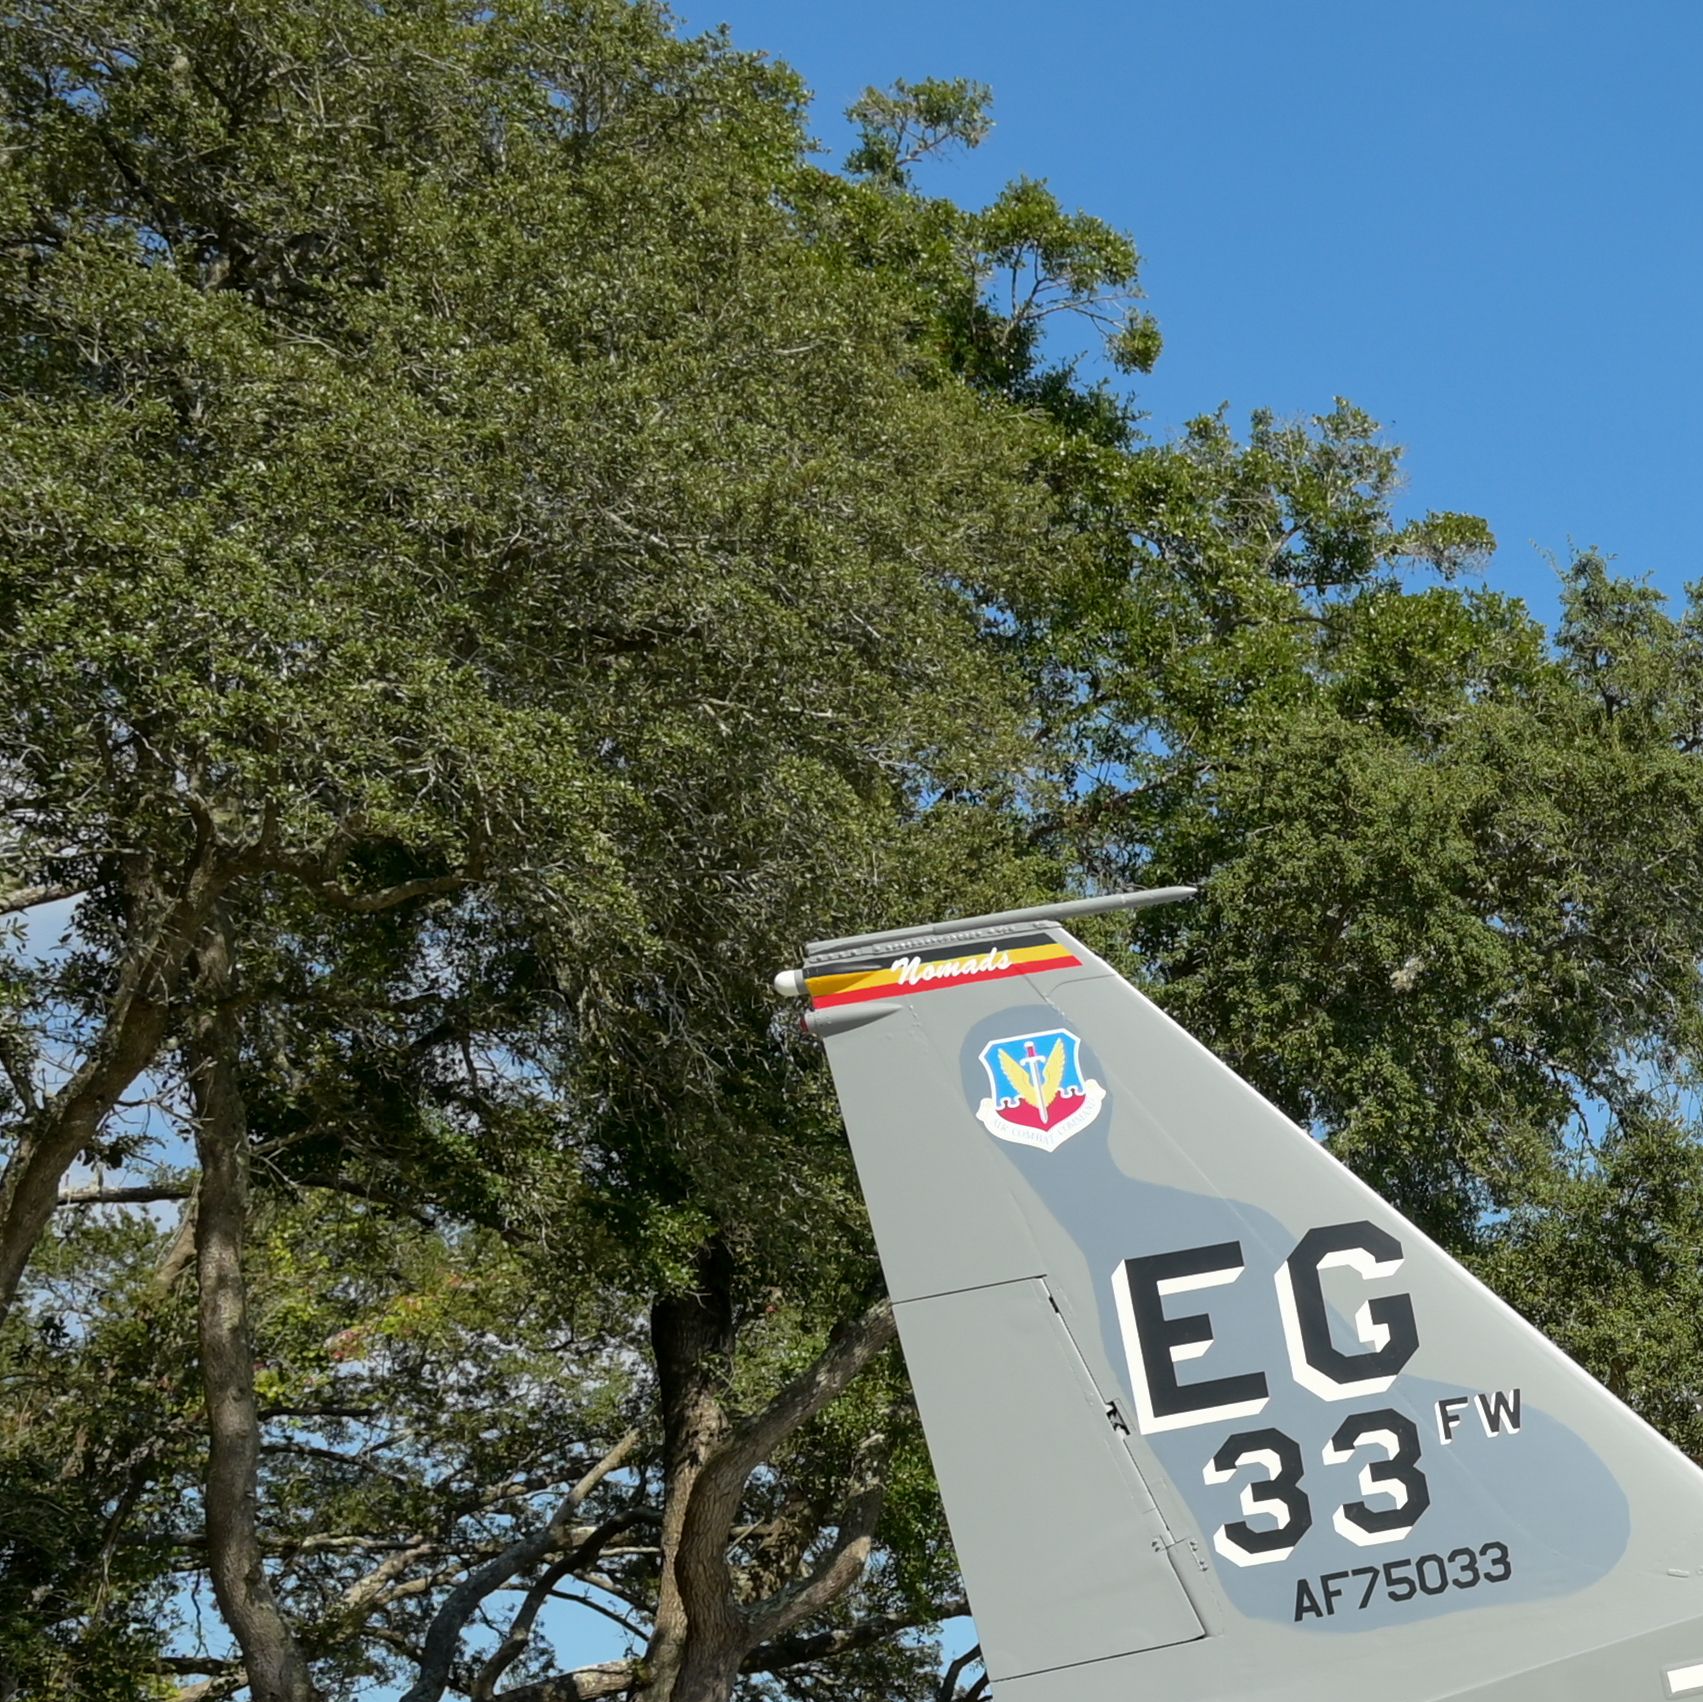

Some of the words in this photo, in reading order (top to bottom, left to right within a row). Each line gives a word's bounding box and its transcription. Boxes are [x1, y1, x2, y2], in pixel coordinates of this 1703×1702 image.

[890, 946, 1012, 985] Nomads
[1111, 1220, 1420, 1435] EG
[1202, 1408, 1431, 1568] 33
[1434, 1388, 1521, 1445] FW
[1294, 1541, 1512, 1622] AF75033
